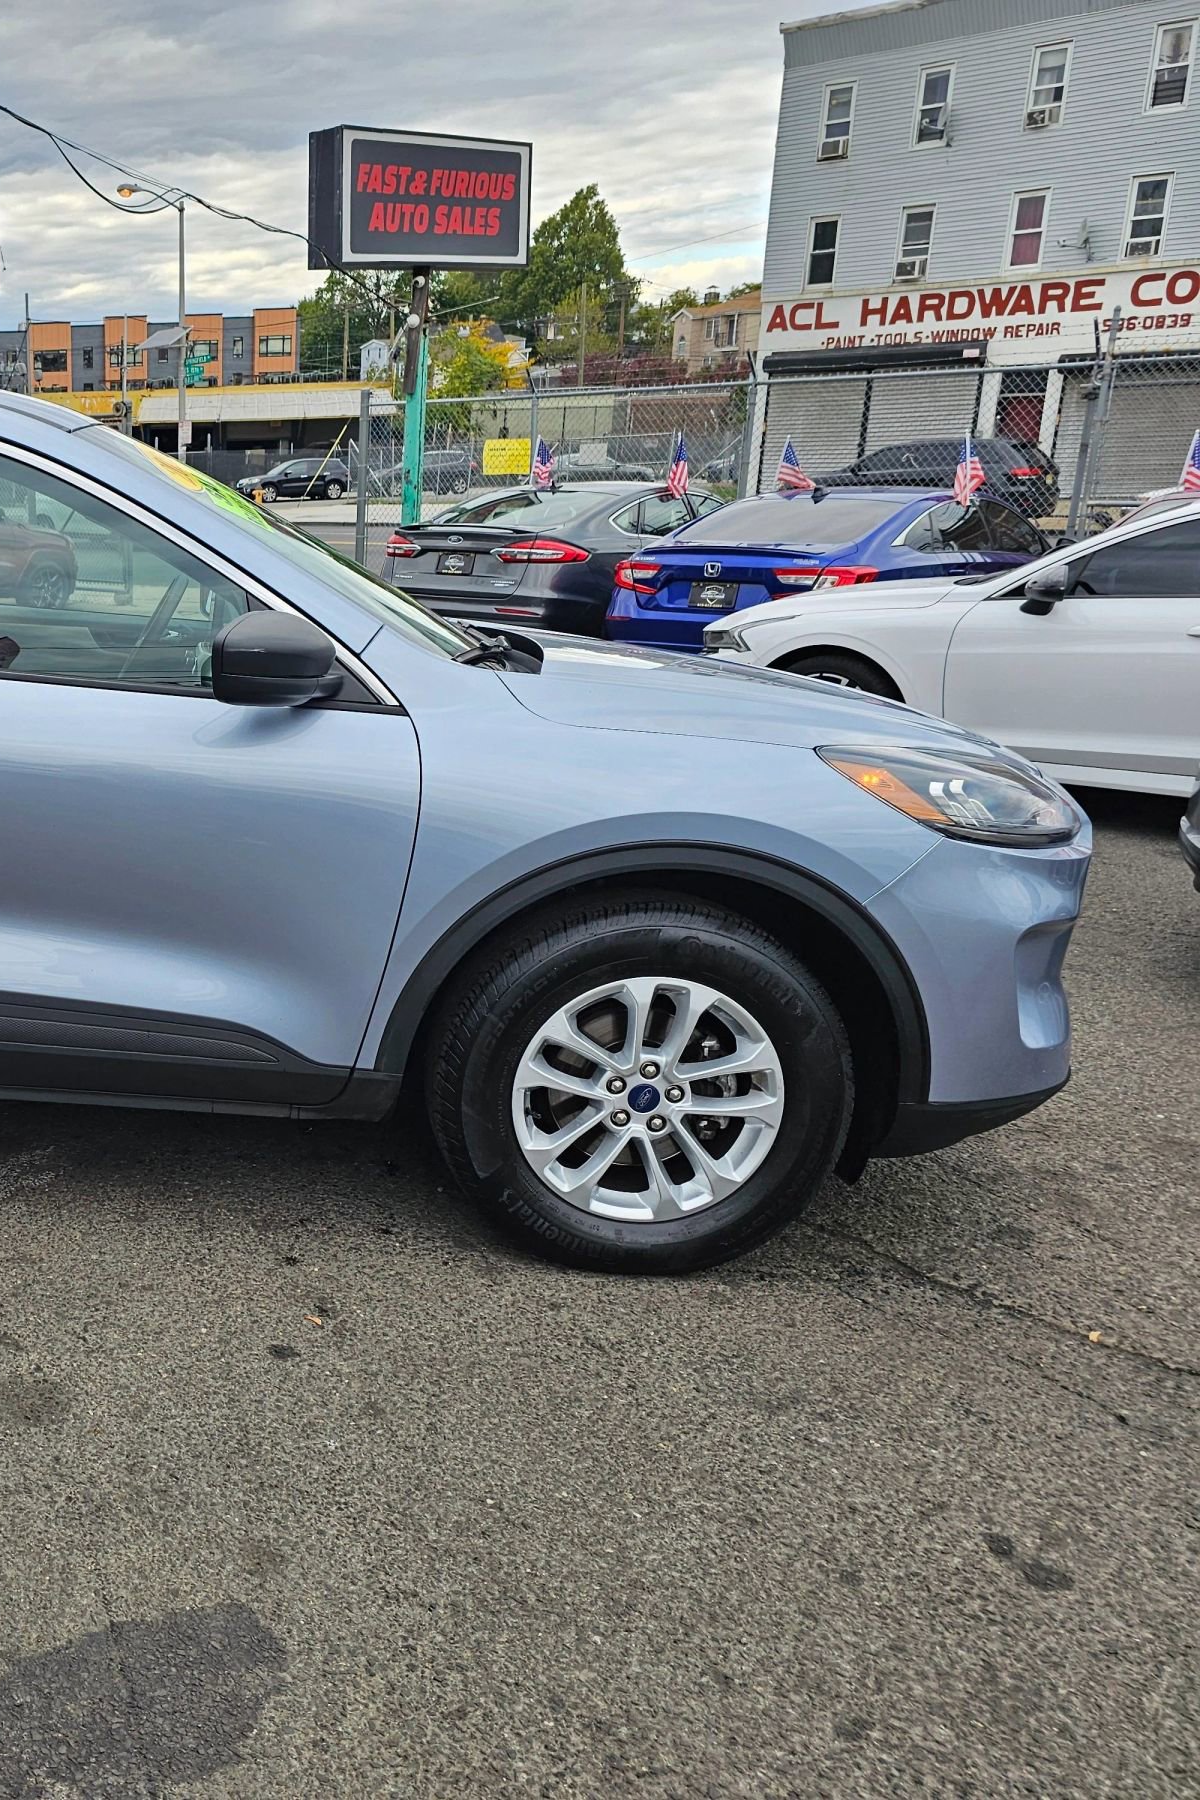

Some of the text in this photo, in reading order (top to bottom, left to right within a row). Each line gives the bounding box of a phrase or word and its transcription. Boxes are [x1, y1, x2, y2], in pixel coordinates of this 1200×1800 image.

[357, 163, 516, 201] FAST & FURIOUS
[368, 202, 502, 236] AUTO SALES
[766, 270, 1200, 333] ACL HARDWARE CO
[825, 321, 1062, 350] PAINT TOOLS WINDOW REPAIR
